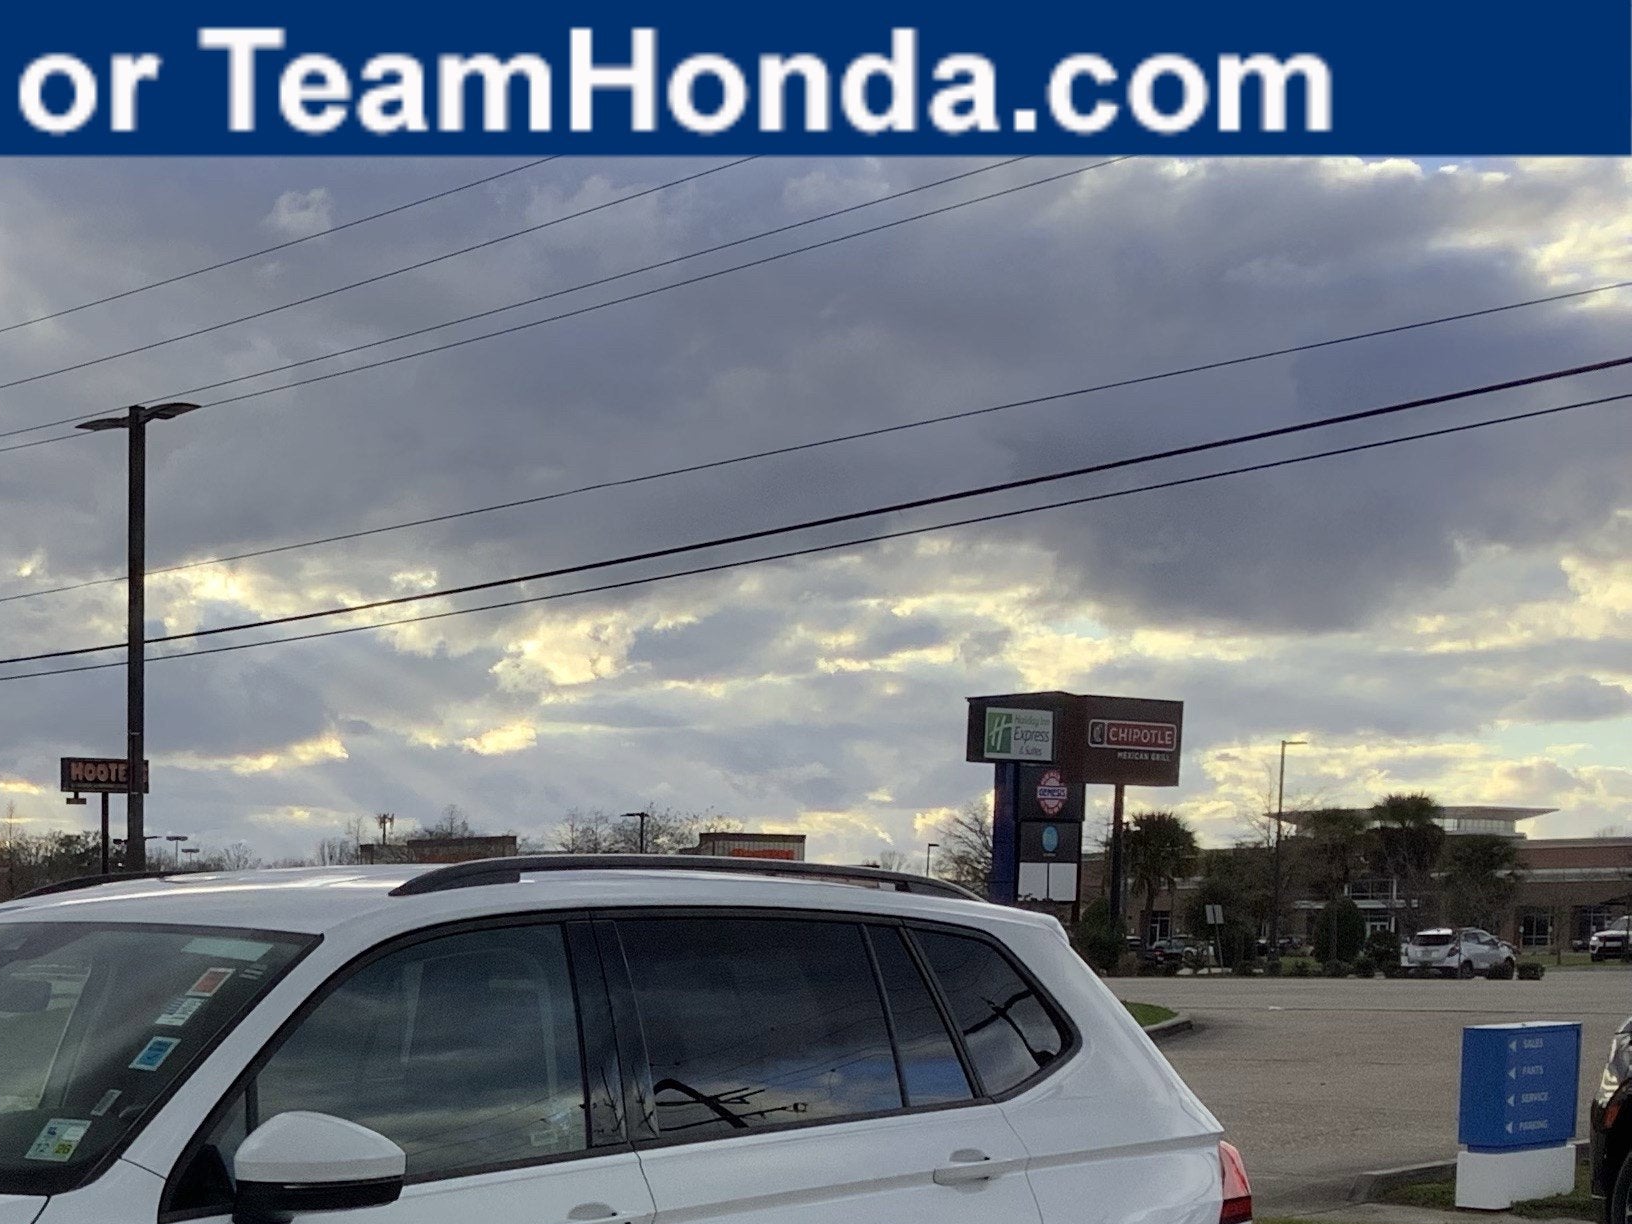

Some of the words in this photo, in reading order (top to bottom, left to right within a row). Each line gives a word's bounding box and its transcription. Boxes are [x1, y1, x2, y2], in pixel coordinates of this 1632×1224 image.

[1013, 726, 1050, 744] Express
[1108, 726, 1173, 745] CHIPOTLE
[1118, 752, 1149, 761] MEXICAN
[1151, 753, 1171, 762] GRILL
[70, 762, 148, 782] HOOTE
[1522, 1037, 1544, 1049] SALES
[1521, 1065, 1544, 1076] PARTS
[1521, 1092, 1549, 1103] SERVICE
